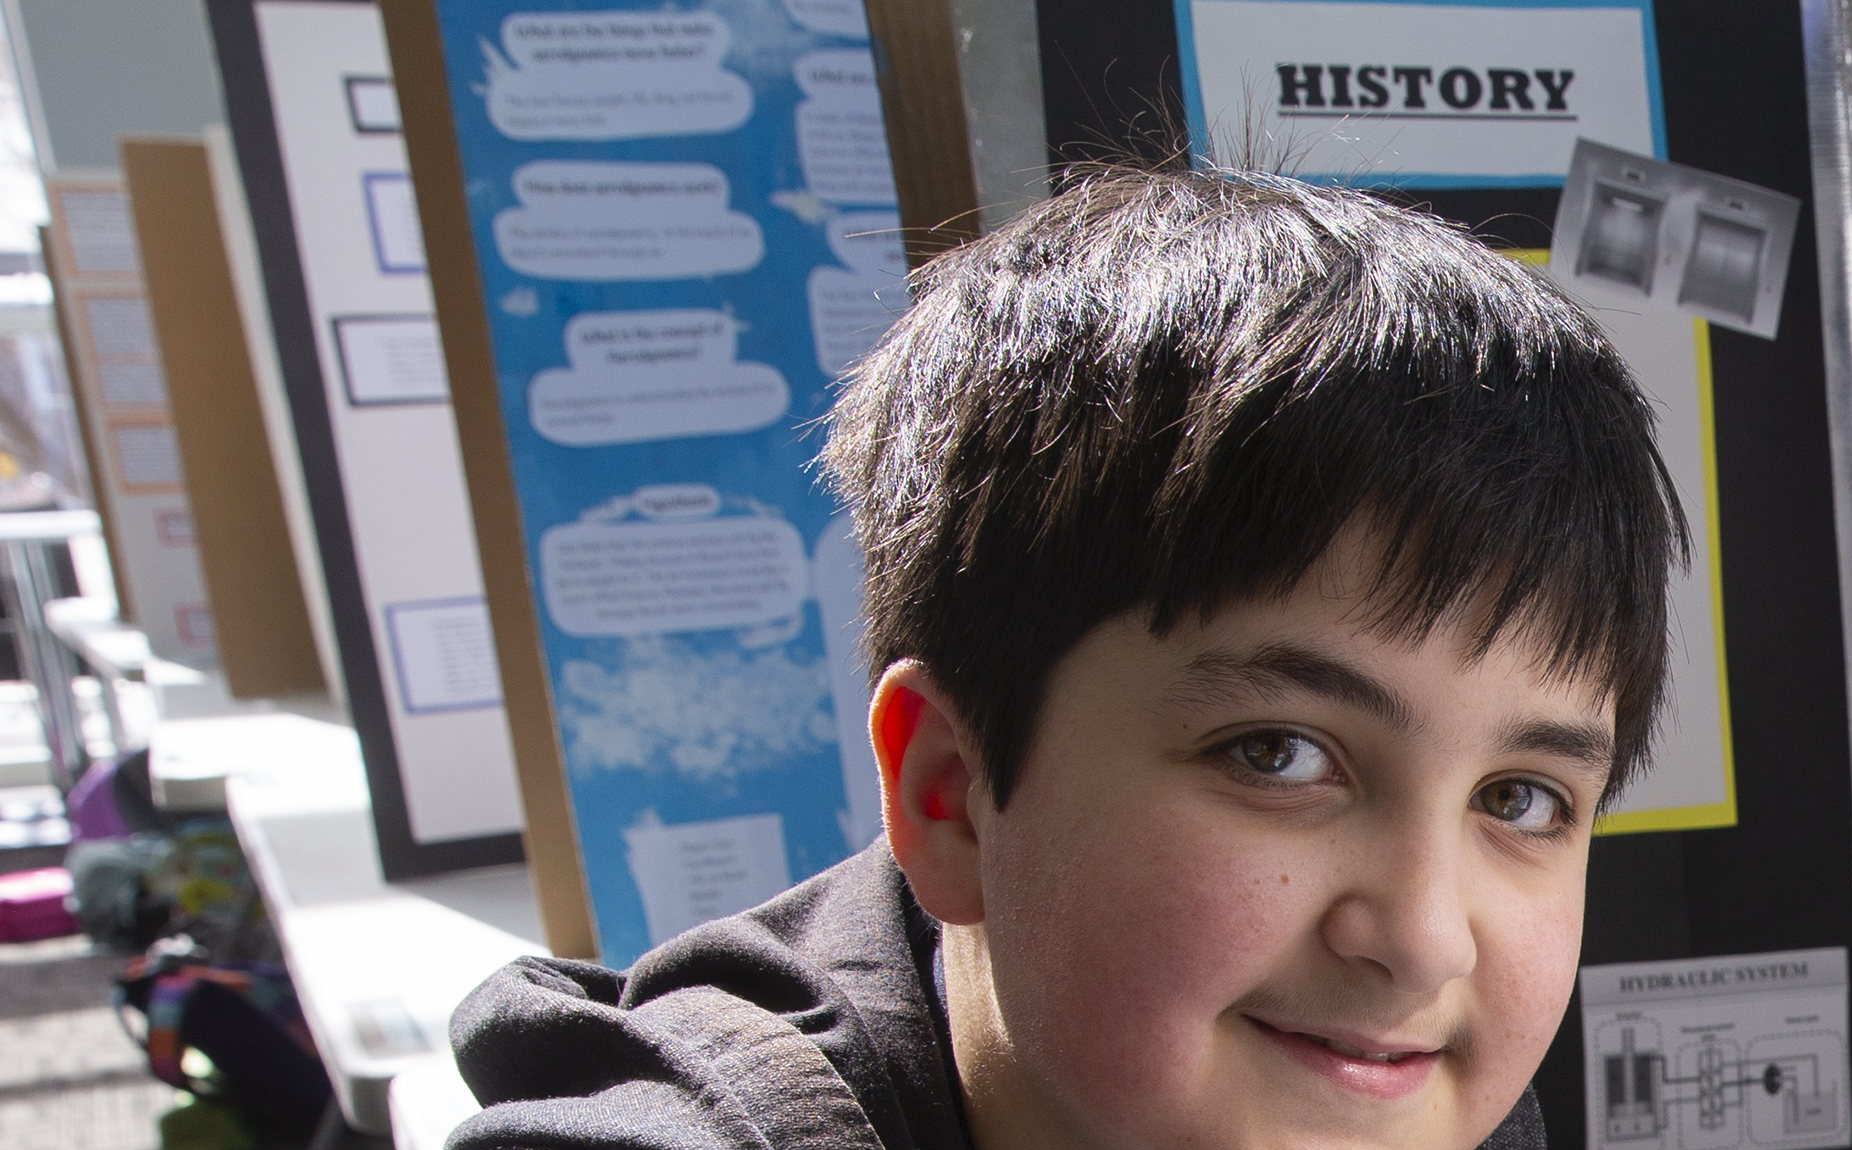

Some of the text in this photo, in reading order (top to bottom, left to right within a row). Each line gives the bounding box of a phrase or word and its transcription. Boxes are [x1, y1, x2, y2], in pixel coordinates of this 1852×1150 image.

[1275, 63, 1575, 111] HISTORY
[1619, 961, 1809, 993] HYDRAULIC SYSTEM
